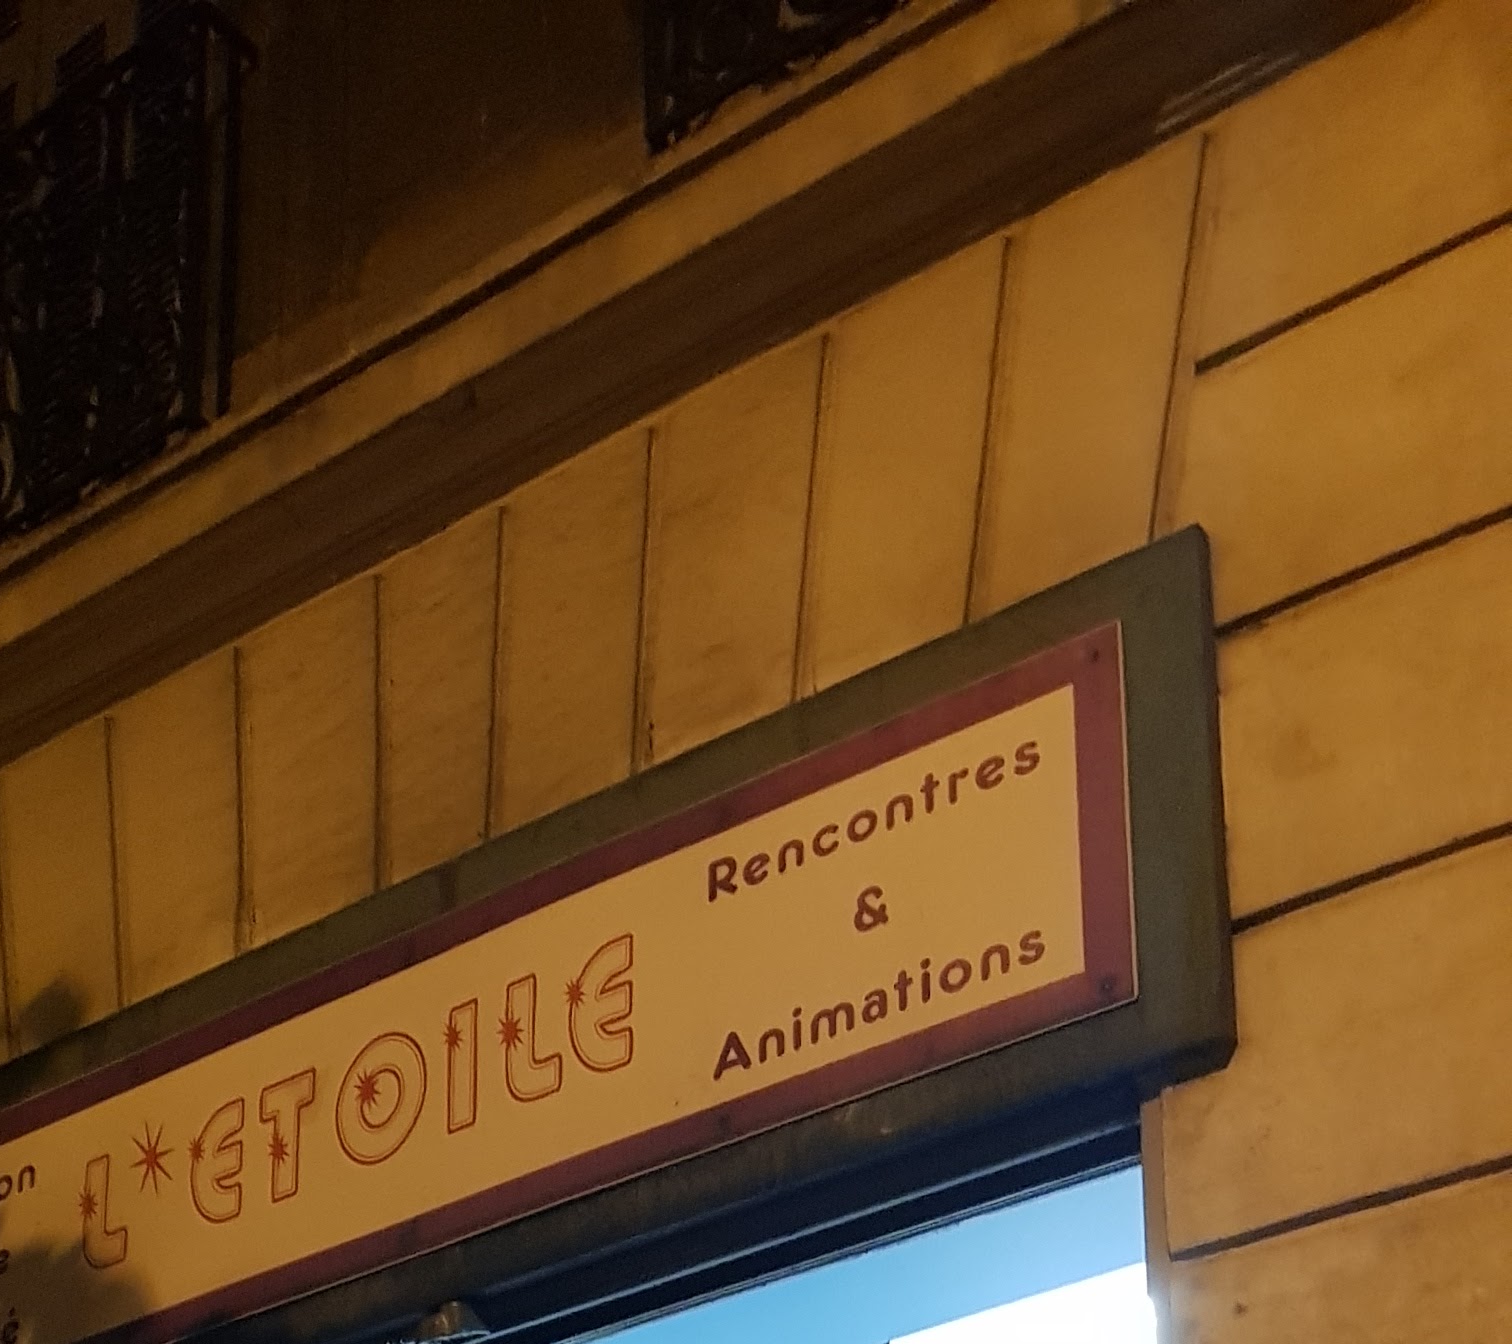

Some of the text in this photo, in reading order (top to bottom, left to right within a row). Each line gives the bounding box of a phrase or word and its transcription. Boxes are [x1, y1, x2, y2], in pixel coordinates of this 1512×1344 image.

[707, 740, 1041, 903] Rencontres
[853, 885, 889, 933] &
[713, 929, 1046, 1081] Animations
